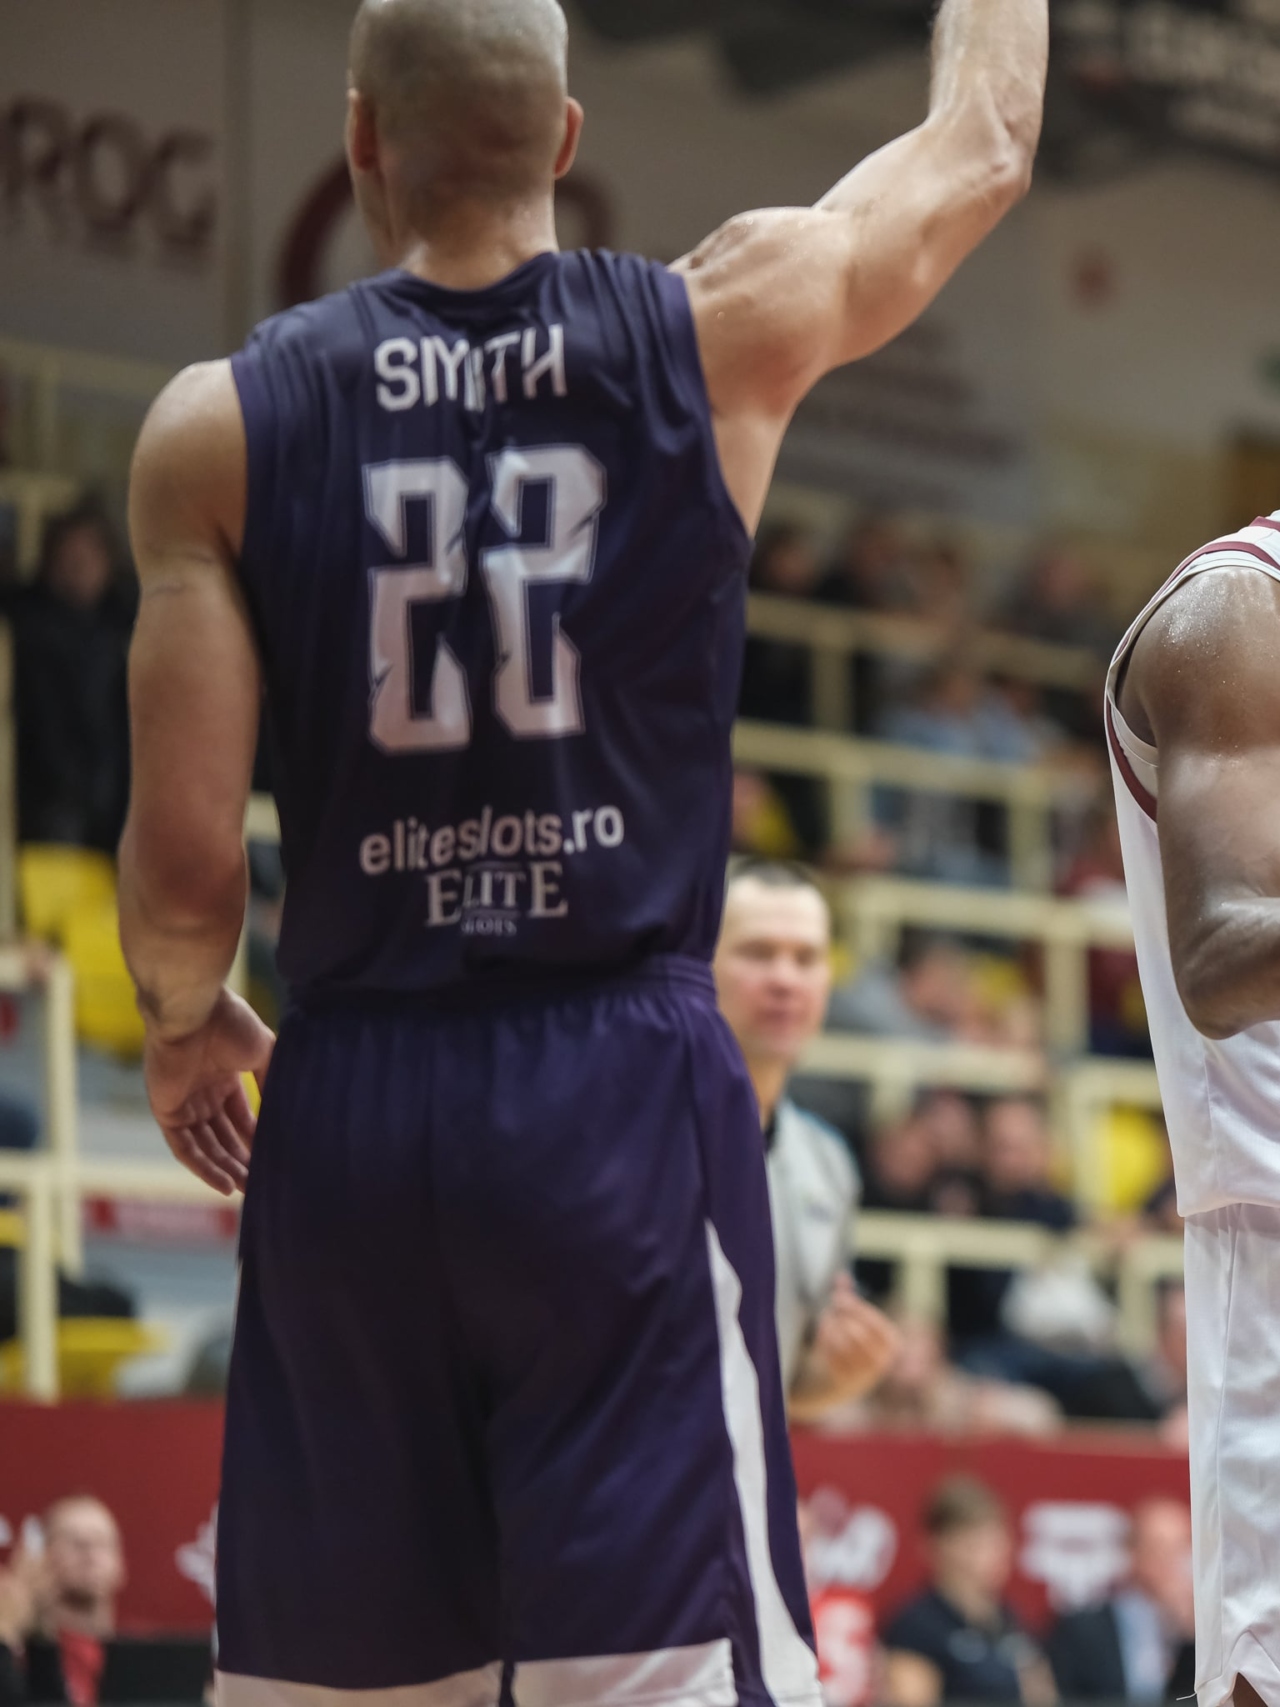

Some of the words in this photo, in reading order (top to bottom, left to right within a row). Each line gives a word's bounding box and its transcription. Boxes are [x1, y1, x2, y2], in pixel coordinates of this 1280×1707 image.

[374, 323, 567, 412] SMITH
[361, 444, 607, 755] 22
[359, 805, 625, 876] eliteslots.ro
[425, 859, 569, 927] ELITE
